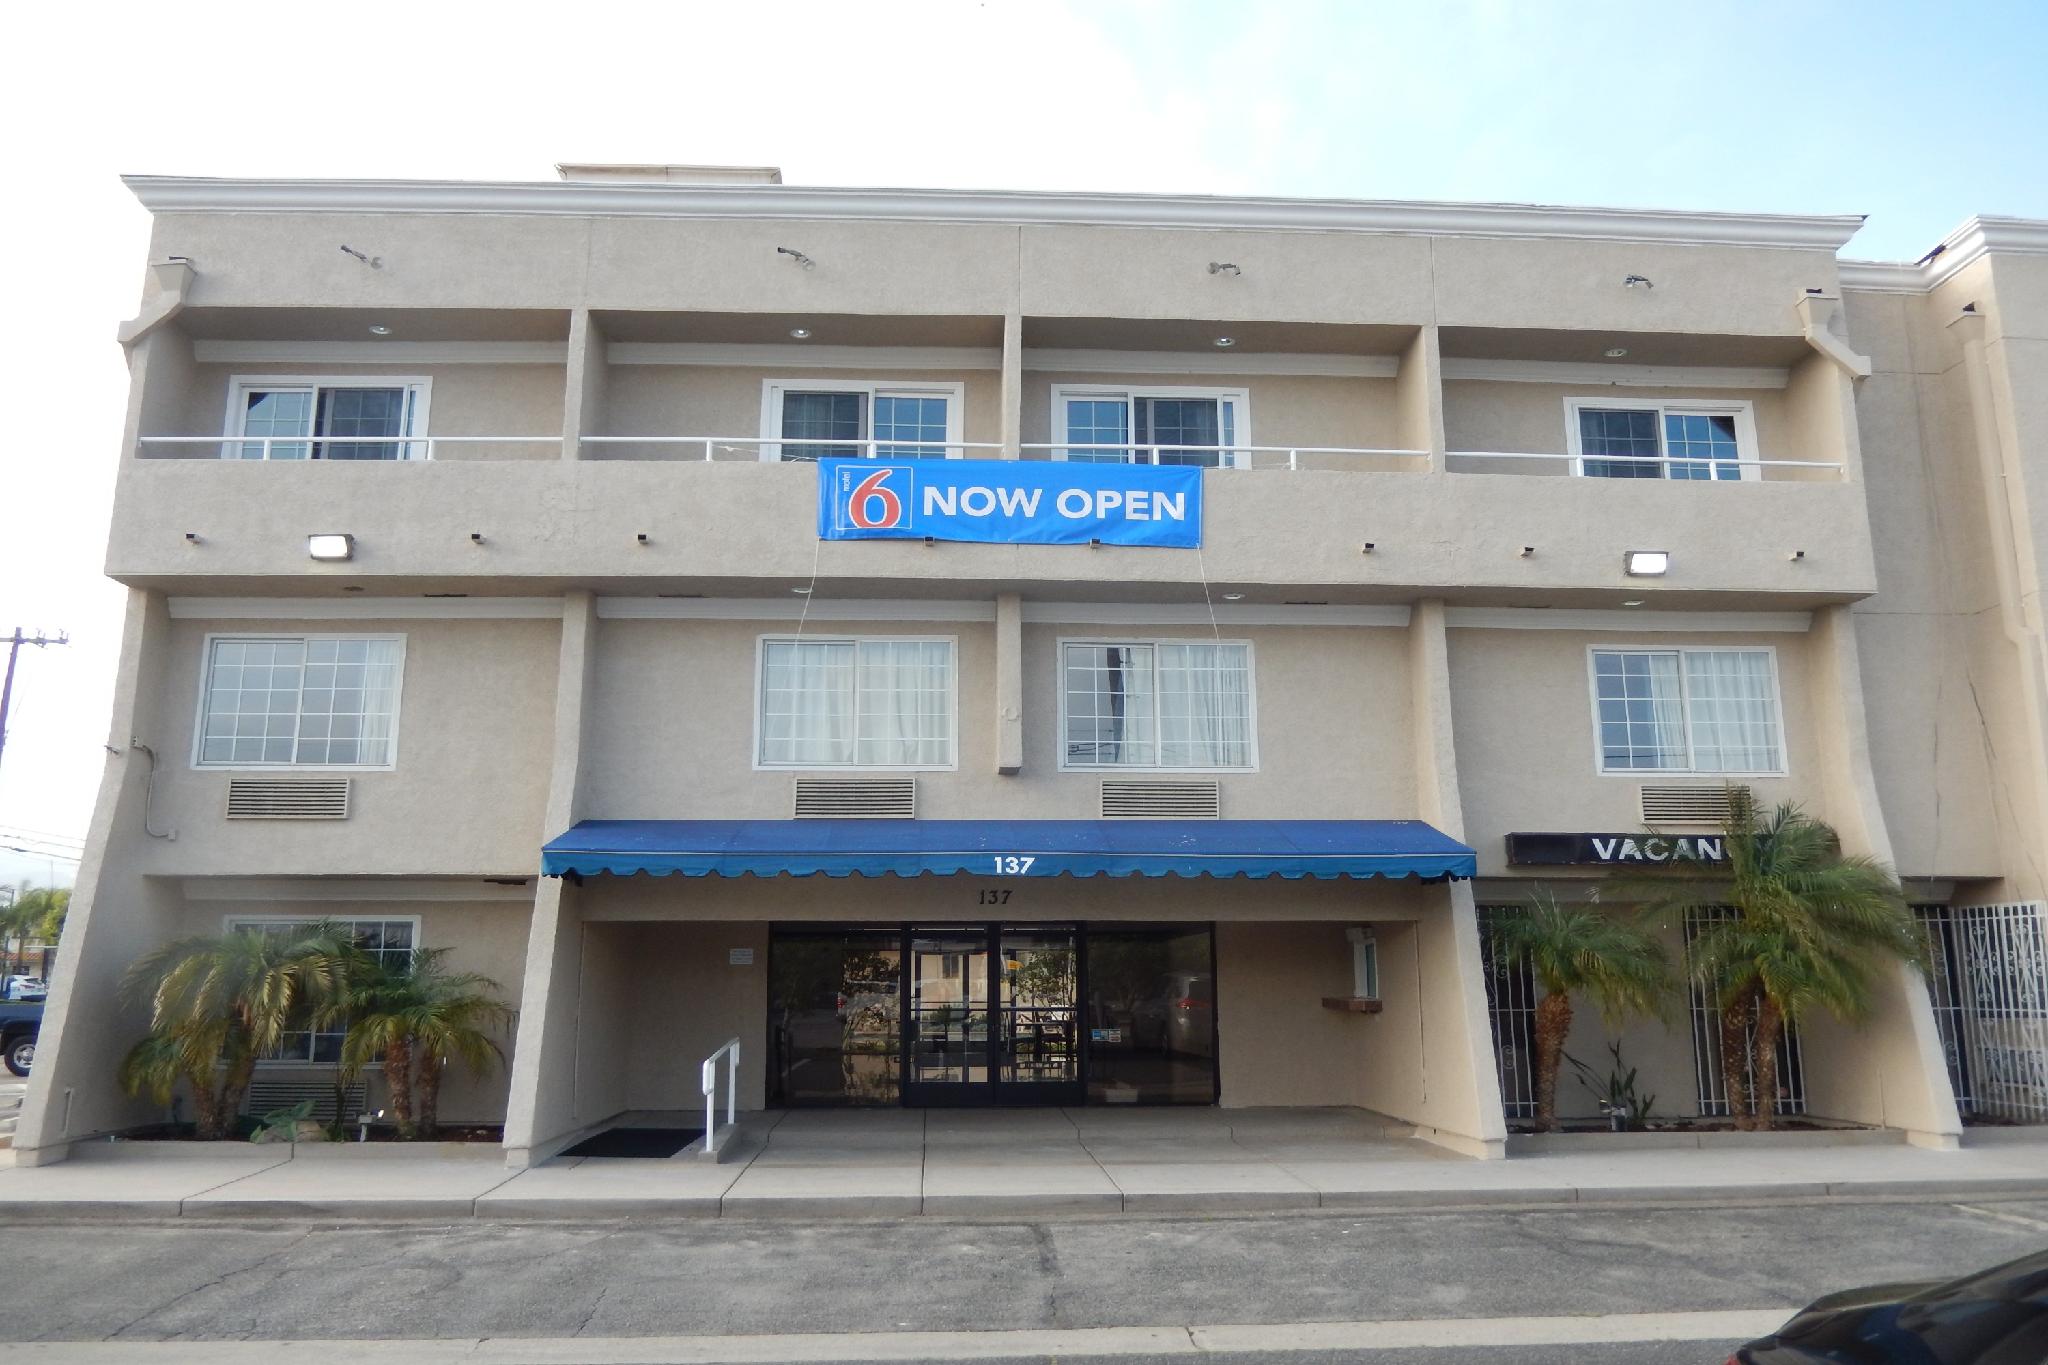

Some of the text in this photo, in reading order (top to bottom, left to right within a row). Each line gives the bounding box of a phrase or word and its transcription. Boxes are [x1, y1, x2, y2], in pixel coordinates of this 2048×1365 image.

[848, 468, 902, 529] 6
[923, 486, 1185, 520] NOW OPEN
[1591, 838, 1770, 861] VACAN
[994, 856, 1036, 874] 137
[979, 889, 1013, 905] 137
